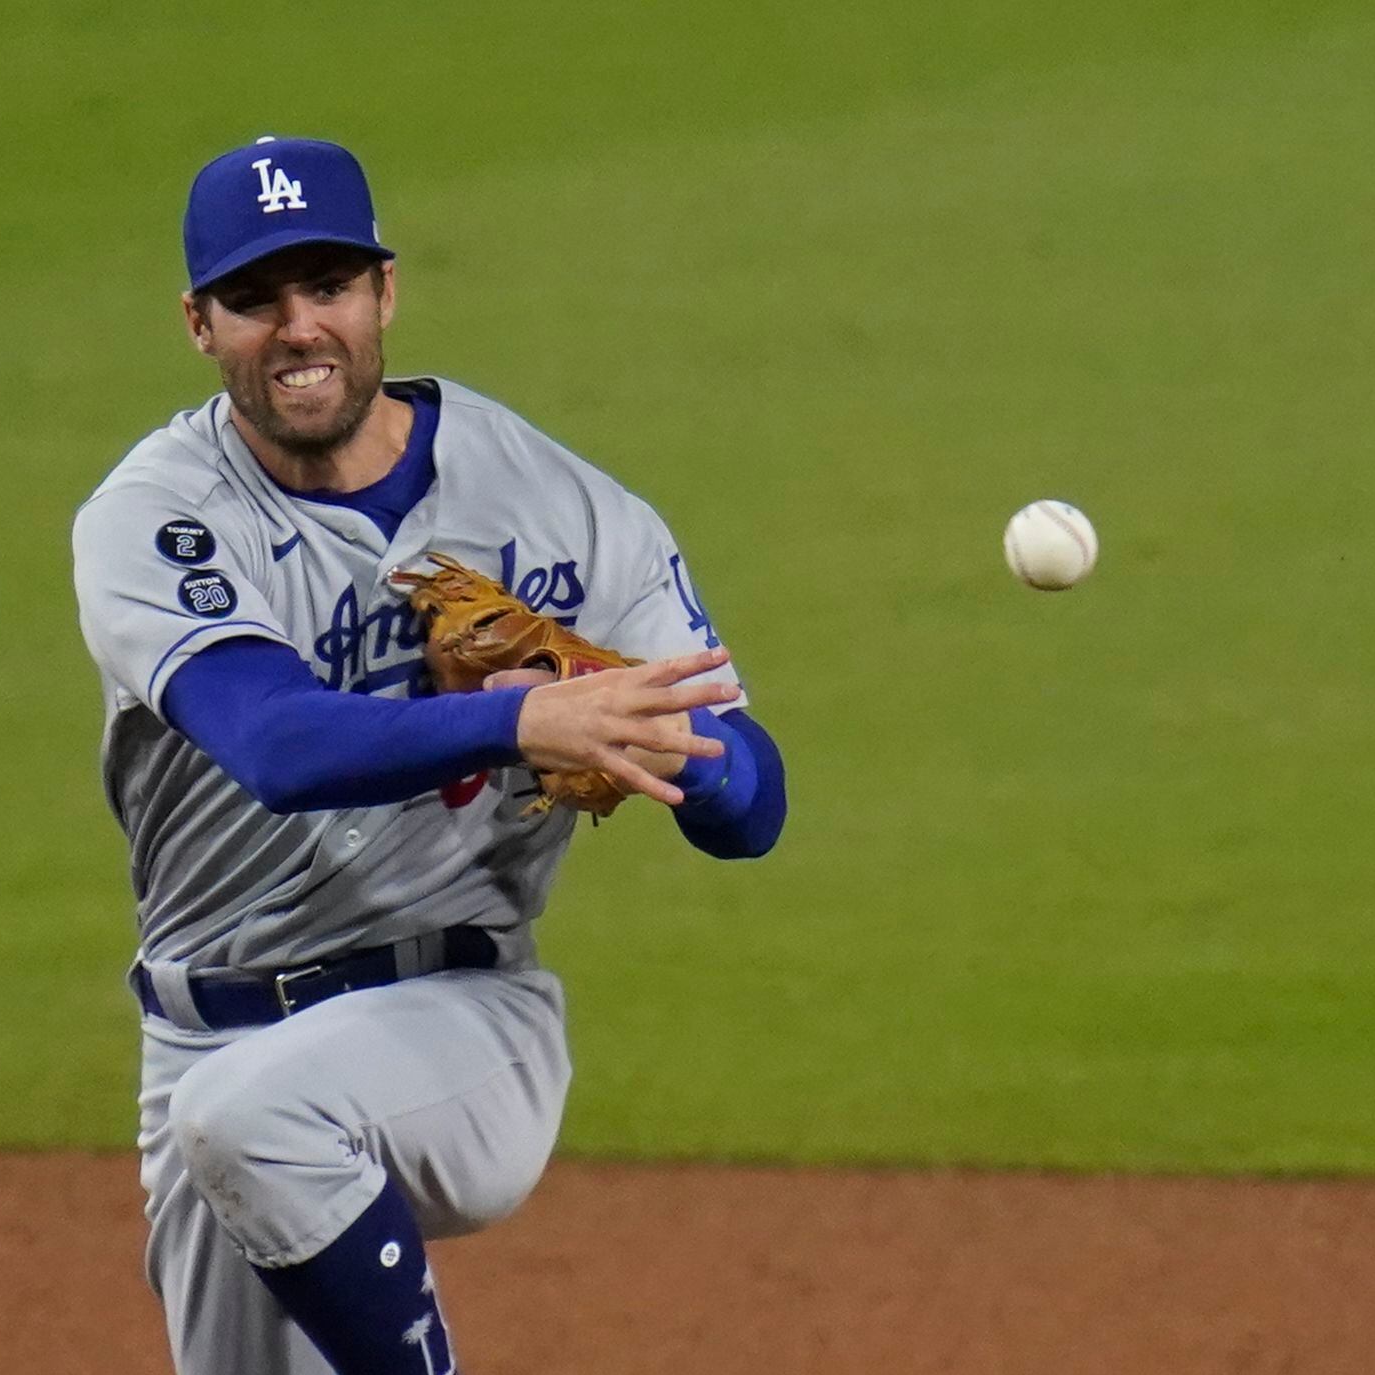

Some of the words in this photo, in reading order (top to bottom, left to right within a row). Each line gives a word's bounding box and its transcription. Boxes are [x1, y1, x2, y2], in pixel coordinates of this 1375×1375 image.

[251, 157, 307, 213] LA
[166, 526, 205, 536] TOMMY
[176, 535, 196, 557] 2
[184, 576, 221, 589] SUTTON
[189, 585, 230, 612] 20
[313, 537, 586, 692] Anles
